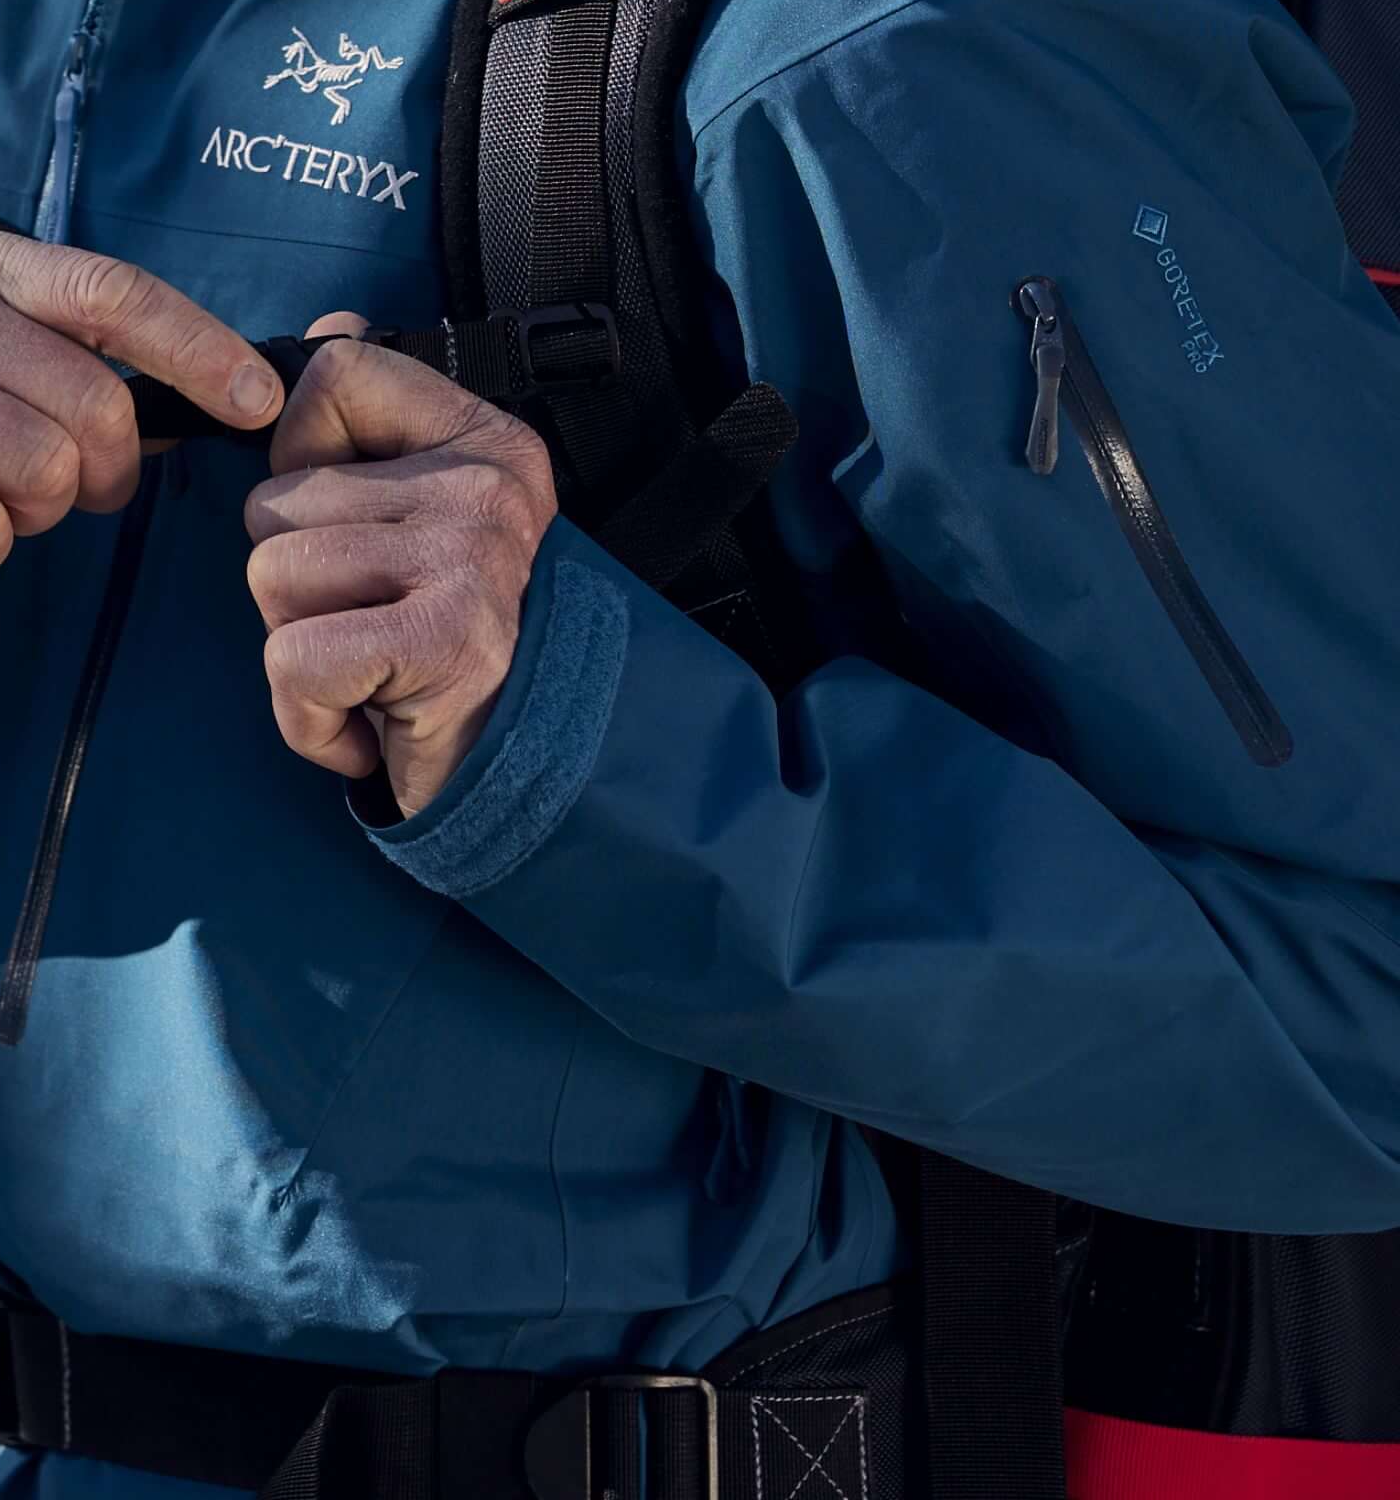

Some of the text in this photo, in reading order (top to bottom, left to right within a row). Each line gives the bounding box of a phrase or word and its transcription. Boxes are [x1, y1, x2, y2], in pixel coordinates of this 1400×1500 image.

[200, 125, 419, 211] ARC'TERYX
[1156, 248, 1225, 365] GORE-TEX
[1181, 339, 1207, 373] PRO
